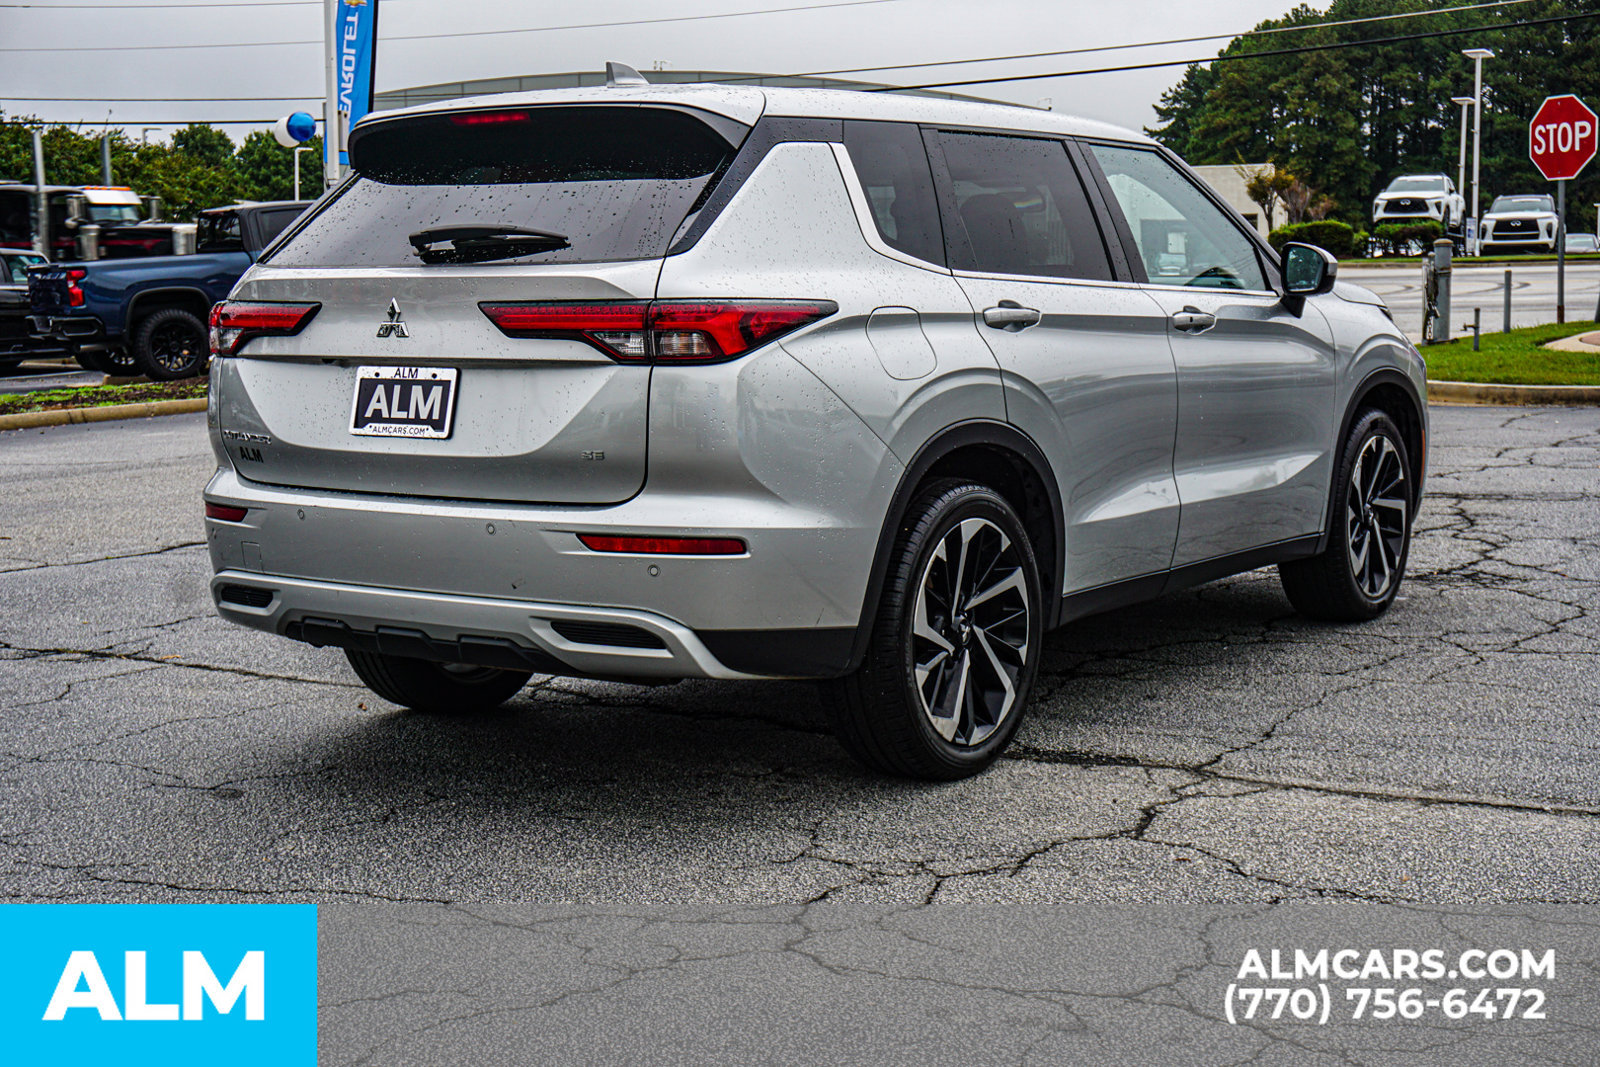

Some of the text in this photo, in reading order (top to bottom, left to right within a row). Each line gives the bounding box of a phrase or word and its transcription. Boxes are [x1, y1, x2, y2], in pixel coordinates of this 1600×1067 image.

[1533, 120, 1592, 155] STOP
[393, 367, 419, 379] ALM
[363, 383, 443, 420] ALM
[372, 424, 426, 435] ALMCARS.COM
[239, 445, 264, 463] ALM
